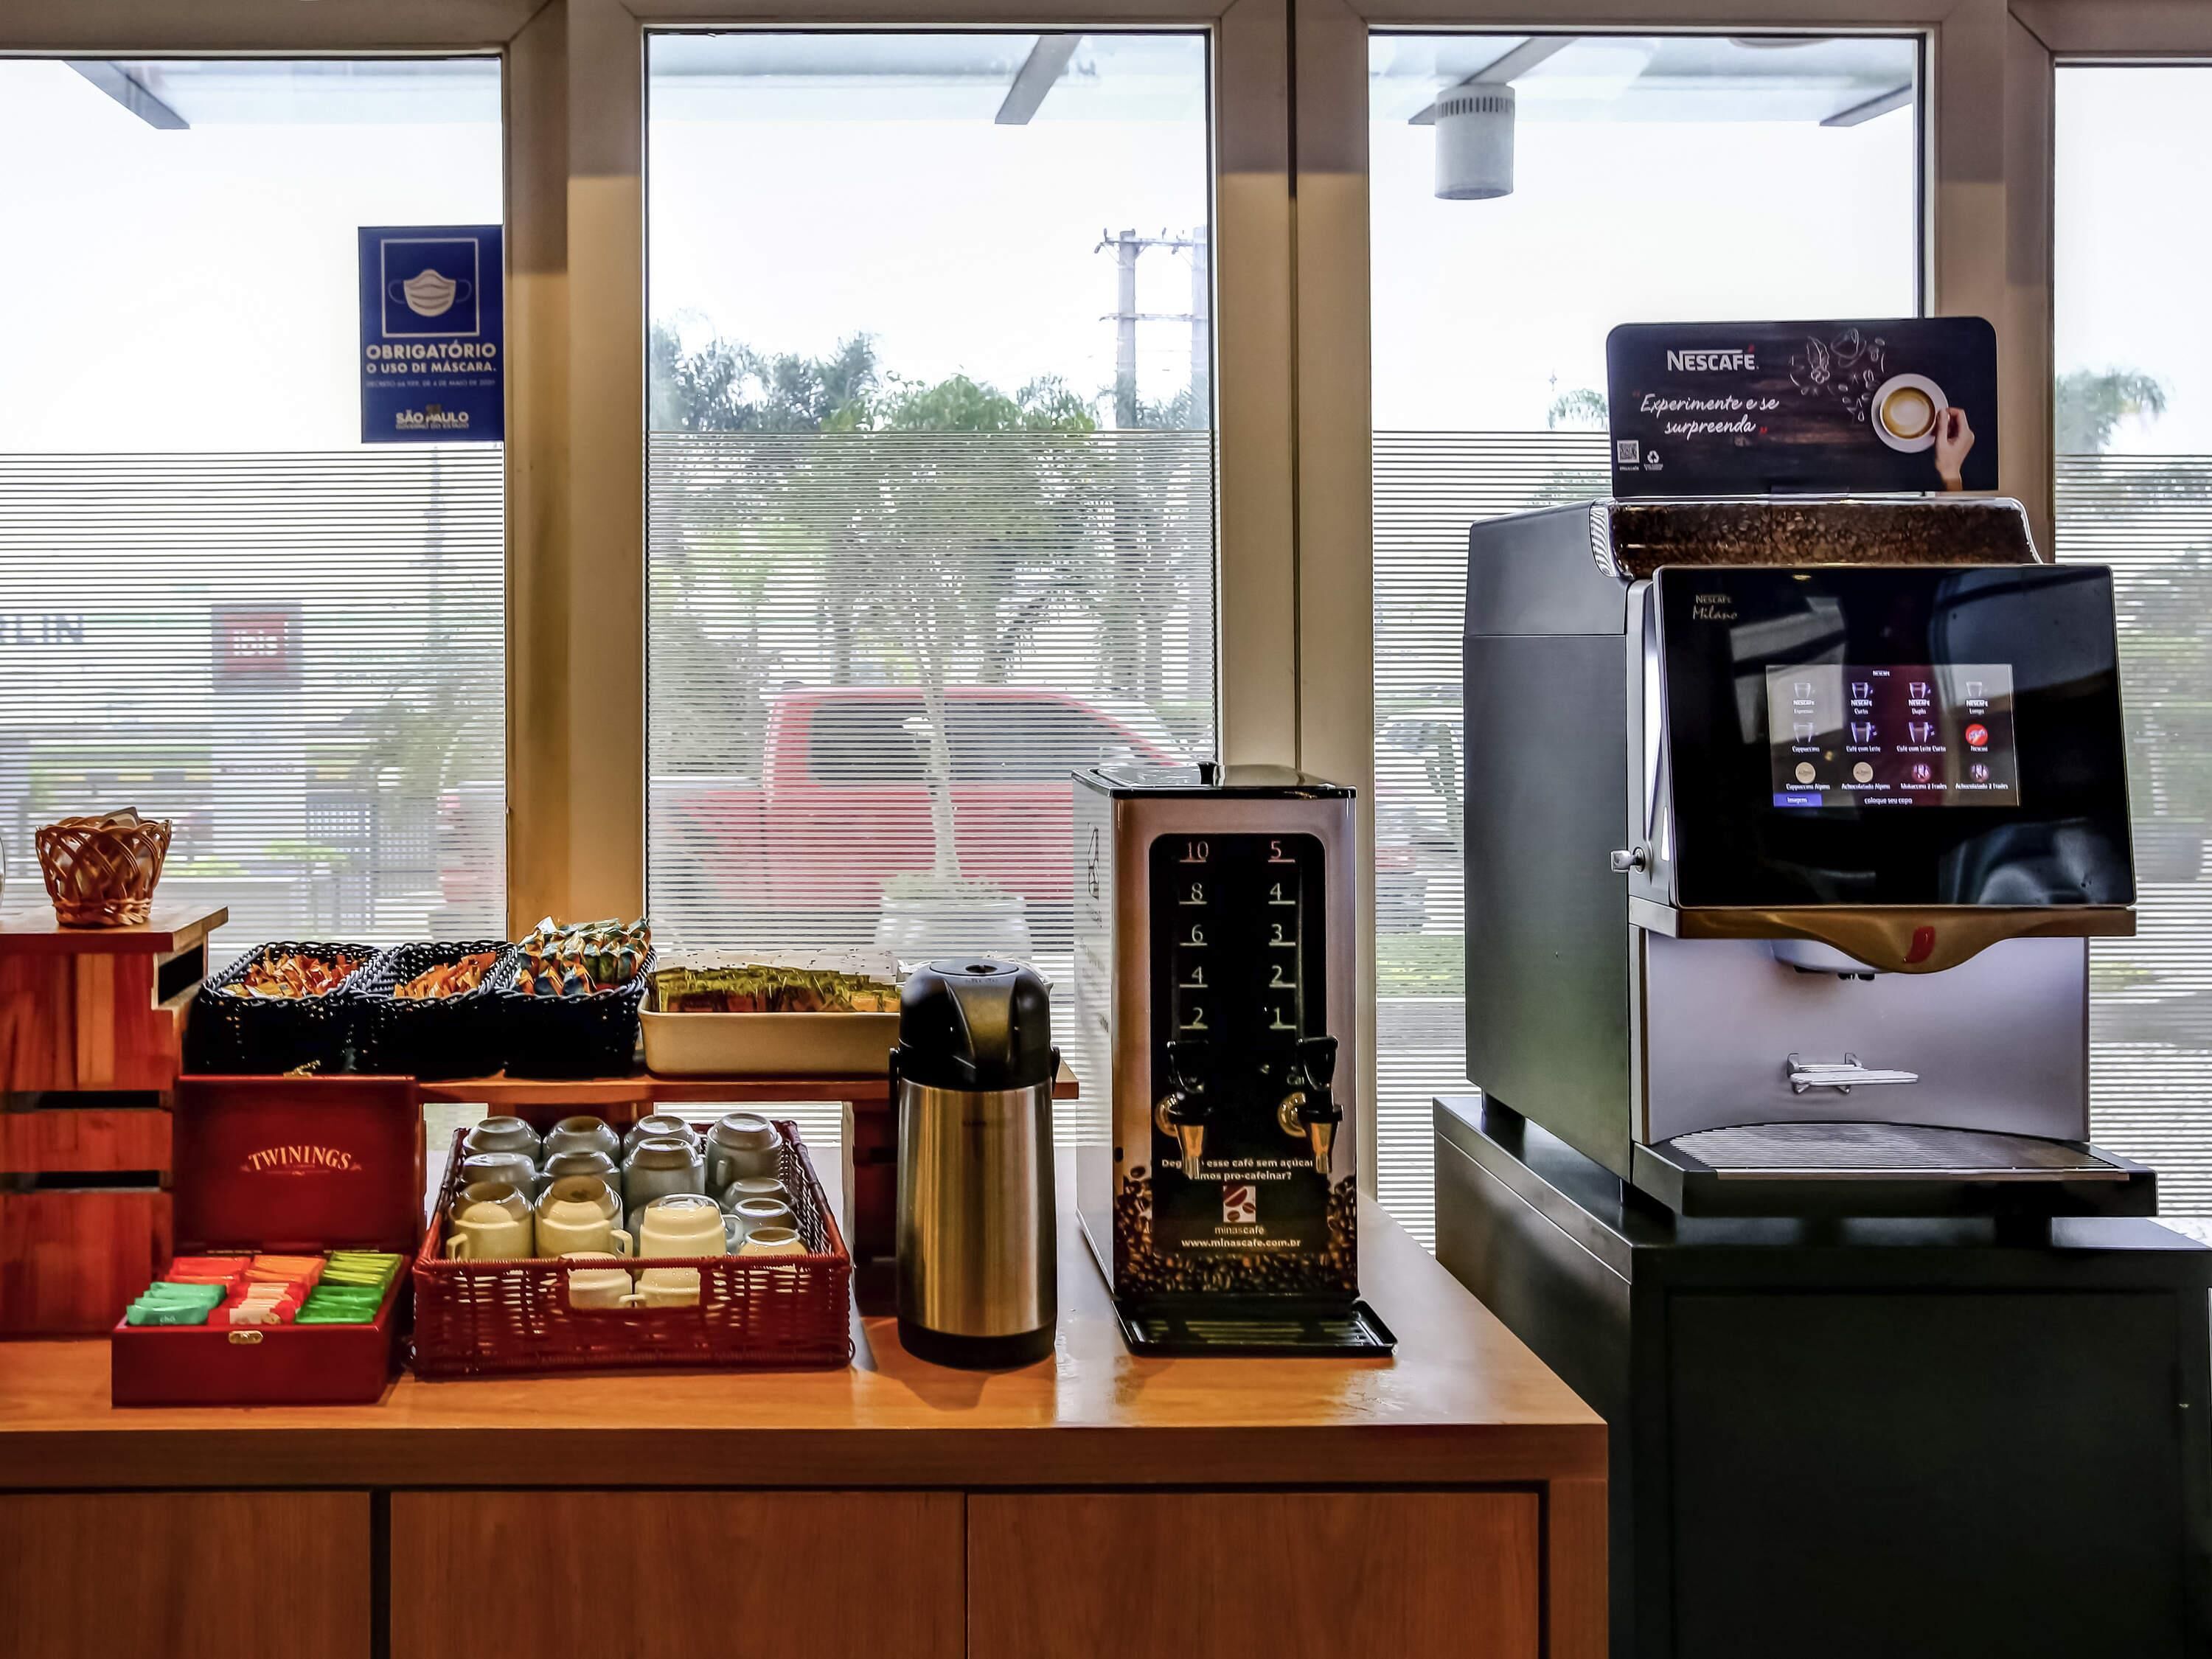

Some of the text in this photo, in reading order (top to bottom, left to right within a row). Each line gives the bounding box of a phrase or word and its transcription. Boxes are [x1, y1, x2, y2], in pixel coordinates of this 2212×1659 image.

[366, 339, 497, 360] OBRIGATÓRIO
[366, 360, 496, 374] O USO DE MÁSCARA.
[1745, 399, 1758, 410] e
[1759, 397, 1780, 410] se
[396, 409, 469, 423] SÃO PAULO
[1692, 605, 1739, 619] Milano
[233, 630, 278, 656] ibis
[1188, 841, 1209, 860] 10
[1270, 841, 1282, 860] 5
[1191, 883, 1203, 902] 8
[1270, 883, 1282, 901] 4
[1192, 924, 1203, 942] 6
[1271, 923, 1282, 942] 3
[1192, 966, 1203, 984] 4
[1271, 965, 1284, 985] 2
[1192, 1007, 1204, 1027] 2
[1273, 1007, 1283, 1026] 1
[248, 1145, 352, 1171] TWININGS
[1206, 1160, 1230, 1168] esse
[1232, 1158, 1253, 1168] café
[1256, 1160, 1278, 1168] sem
[1180, 1238, 1301, 1248] www.minascafe.com.br
